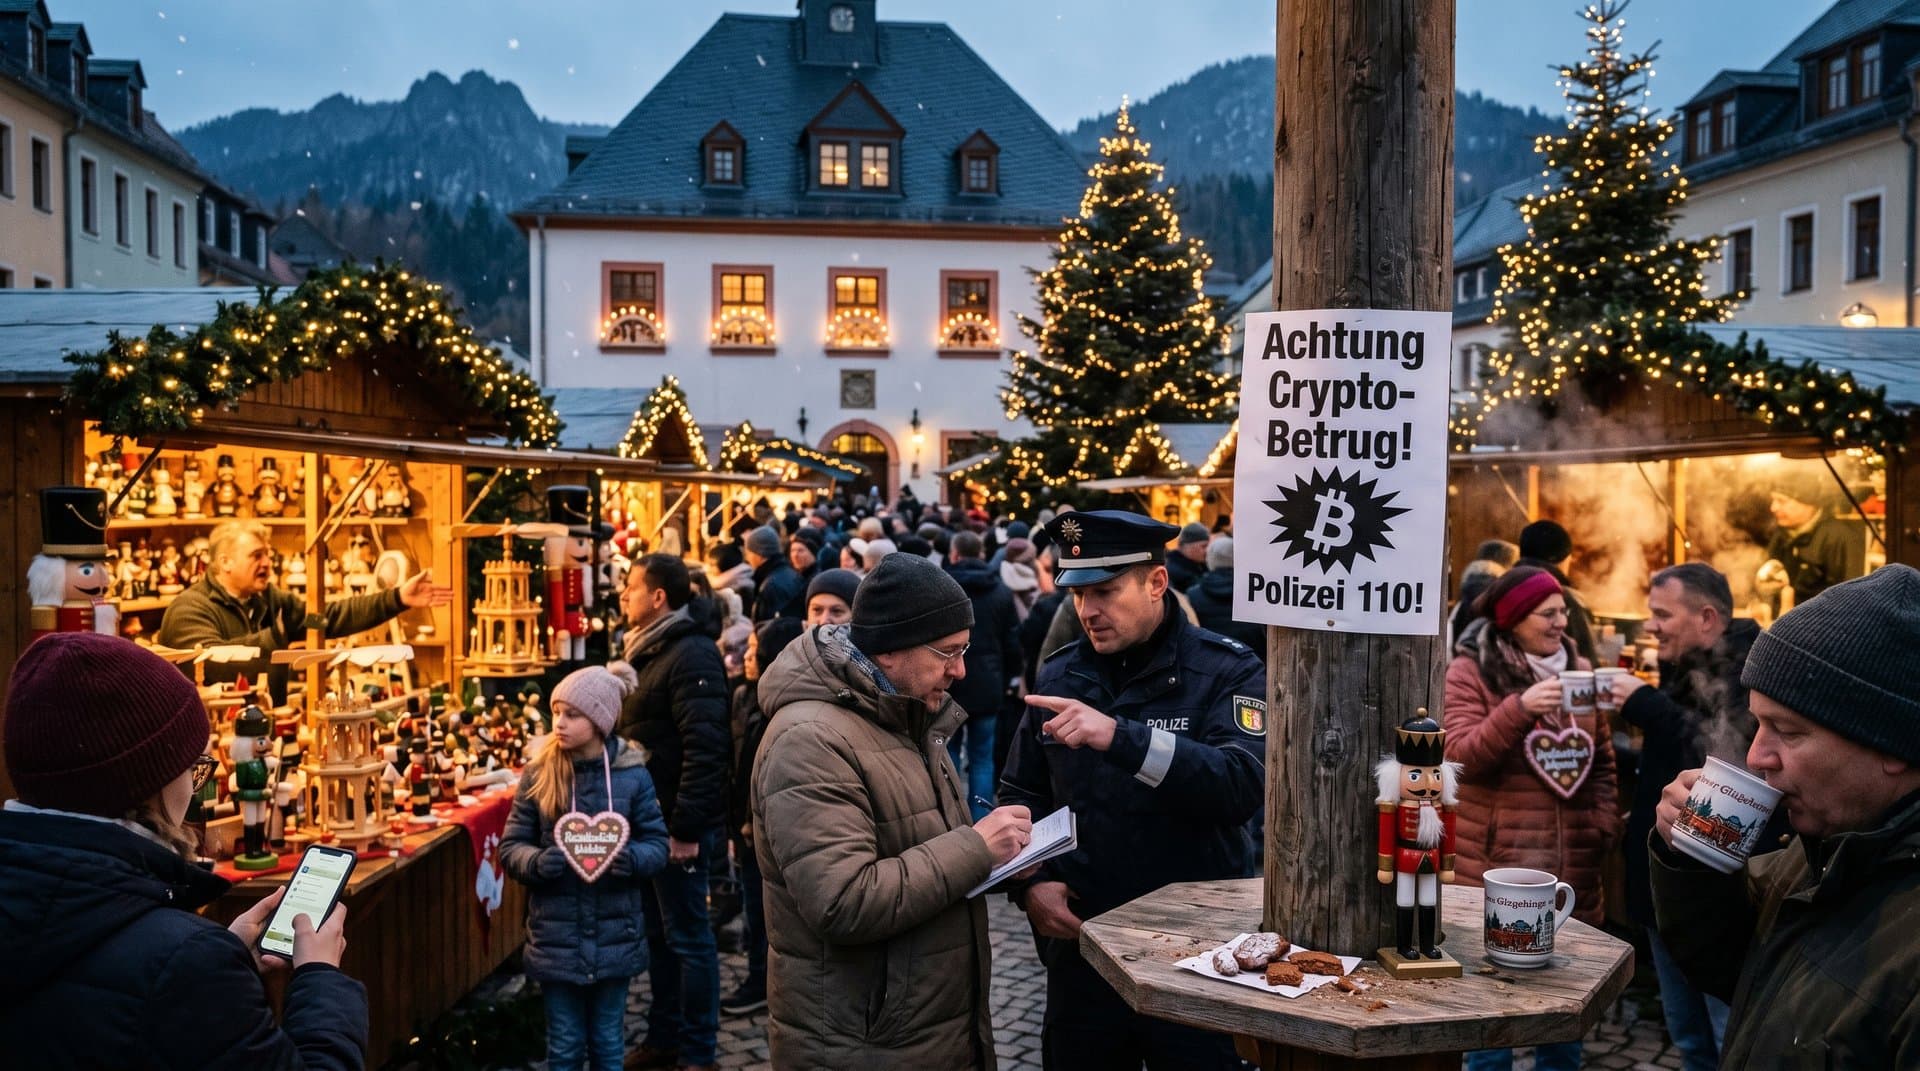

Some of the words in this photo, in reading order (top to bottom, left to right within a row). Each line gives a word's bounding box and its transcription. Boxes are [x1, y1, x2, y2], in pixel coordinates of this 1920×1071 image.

[1262, 322, 1425, 370] Achtung
[1269, 370, 1416, 418] Crypto-
[1266, 419, 1412, 470] Betrug!
[1248, 572, 1345, 611] Polizei
[1358, 580, 1424, 614] 110!
